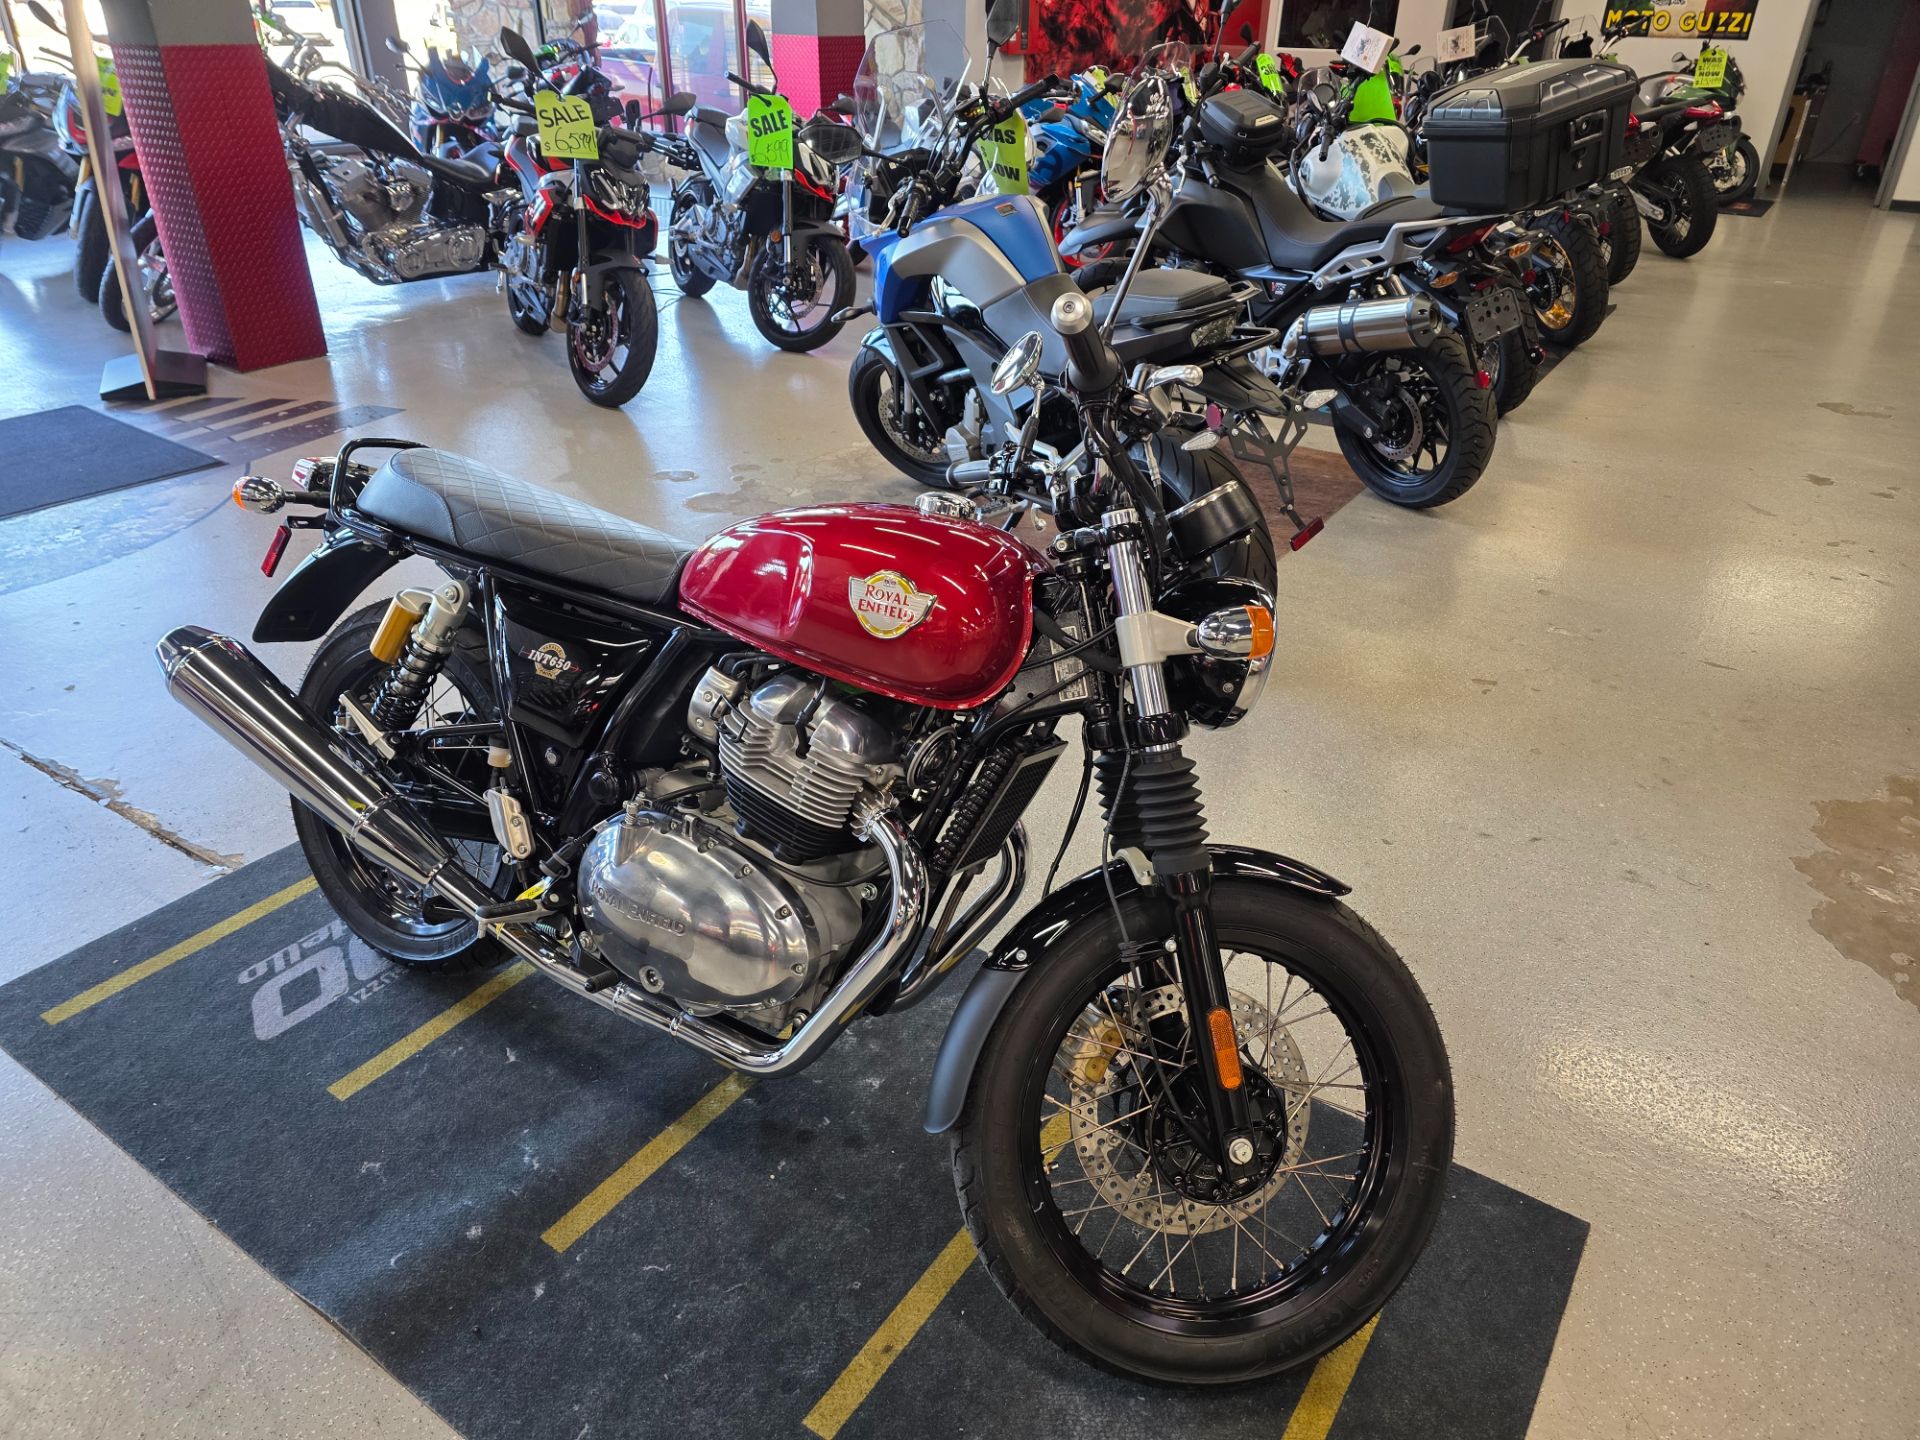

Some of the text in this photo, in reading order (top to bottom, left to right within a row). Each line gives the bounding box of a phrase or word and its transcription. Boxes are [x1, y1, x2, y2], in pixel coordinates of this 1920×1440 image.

[1605, 10, 1751, 33] MTO GUZZI
[538, 104, 590, 128] SALE
[750, 109, 788, 138] SALE
[992, 128, 1017, 145] AS
[865, 584, 910, 606] ROYAL
[857, 598, 915, 622] ENFIELD
[528, 649, 571, 671] INT650
[628, 903, 687, 937] ENFIELD
